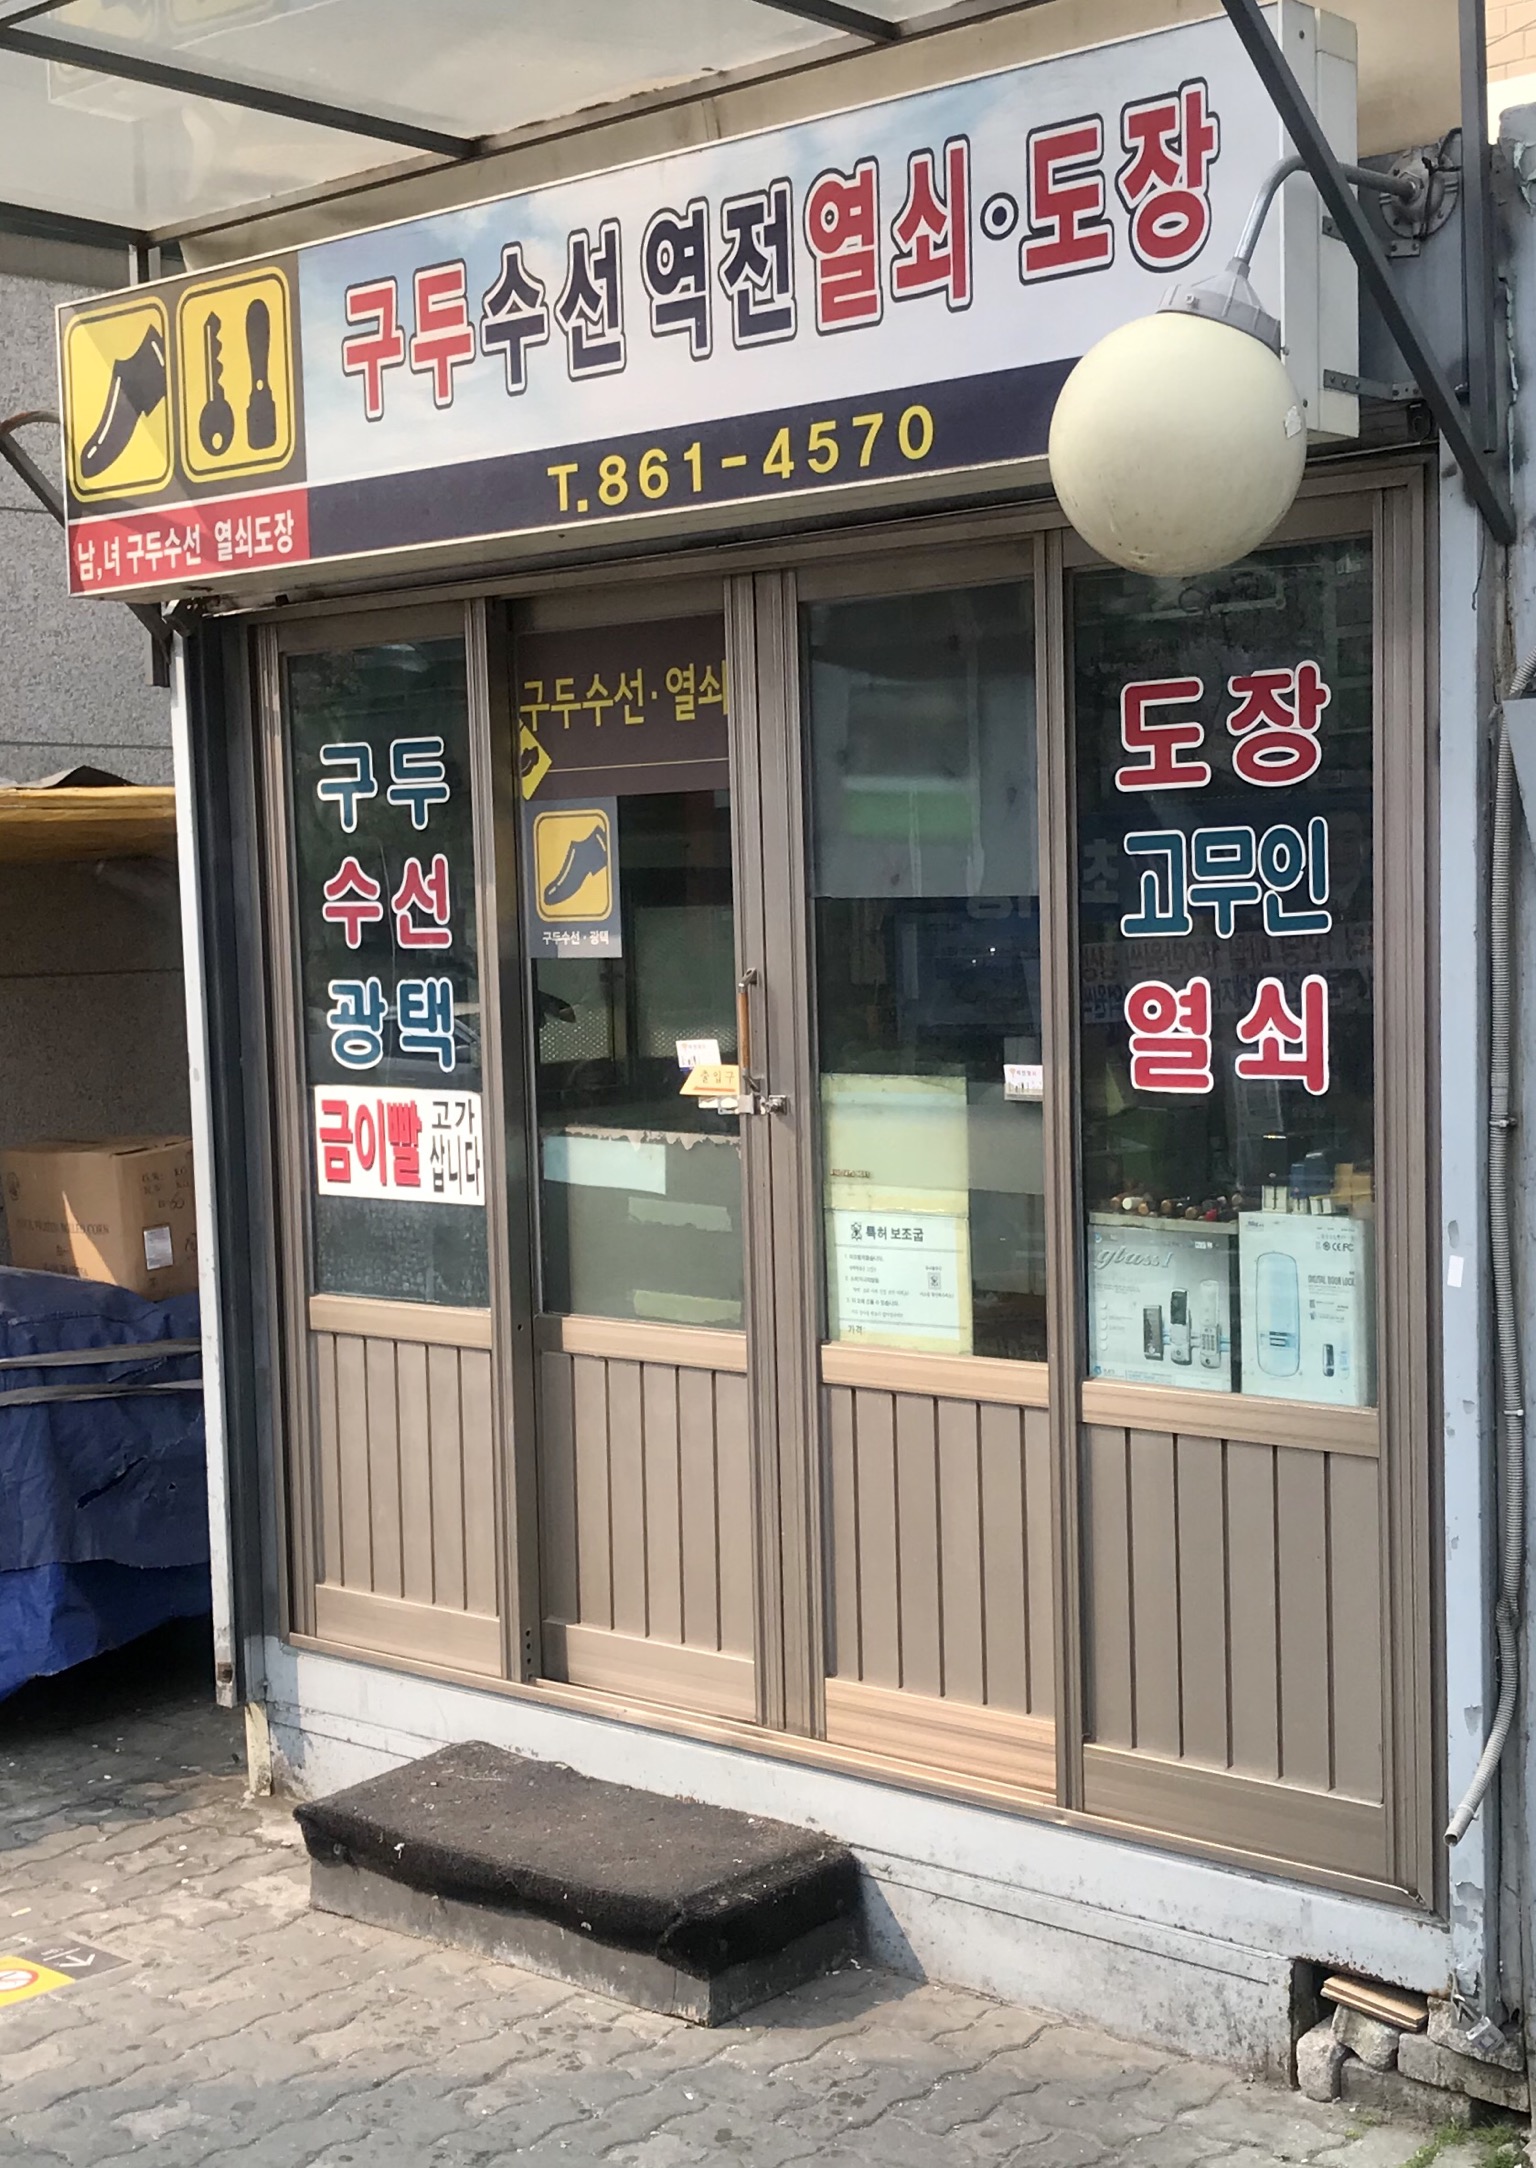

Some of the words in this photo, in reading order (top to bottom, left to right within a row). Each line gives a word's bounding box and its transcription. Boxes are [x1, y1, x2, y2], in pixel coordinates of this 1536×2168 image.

[343, 218, 626, 422] 구두수선
[548, 405, 934, 513] T.861-4570
[126, 523, 201, 575] 구두수선
[214, 509, 294, 562] 열쇠도장
[1115, 659, 1331, 792] 도장
[317, 736, 451, 833] 구두
[322, 853, 453, 949] 수선
[1121, 816, 1332, 939] 고무인
[327, 976, 456, 1073] 광택
[1124, 973, 1330, 1096] 열쇠
[319, 1099, 422, 1187] 금이빨
[430, 1134, 480, 1196] 삽니다
[431, 1099, 475, 1134] 고가
[866, 1225, 888, 1240] 특허
[890, 1227, 924, 1242] 보조굽
